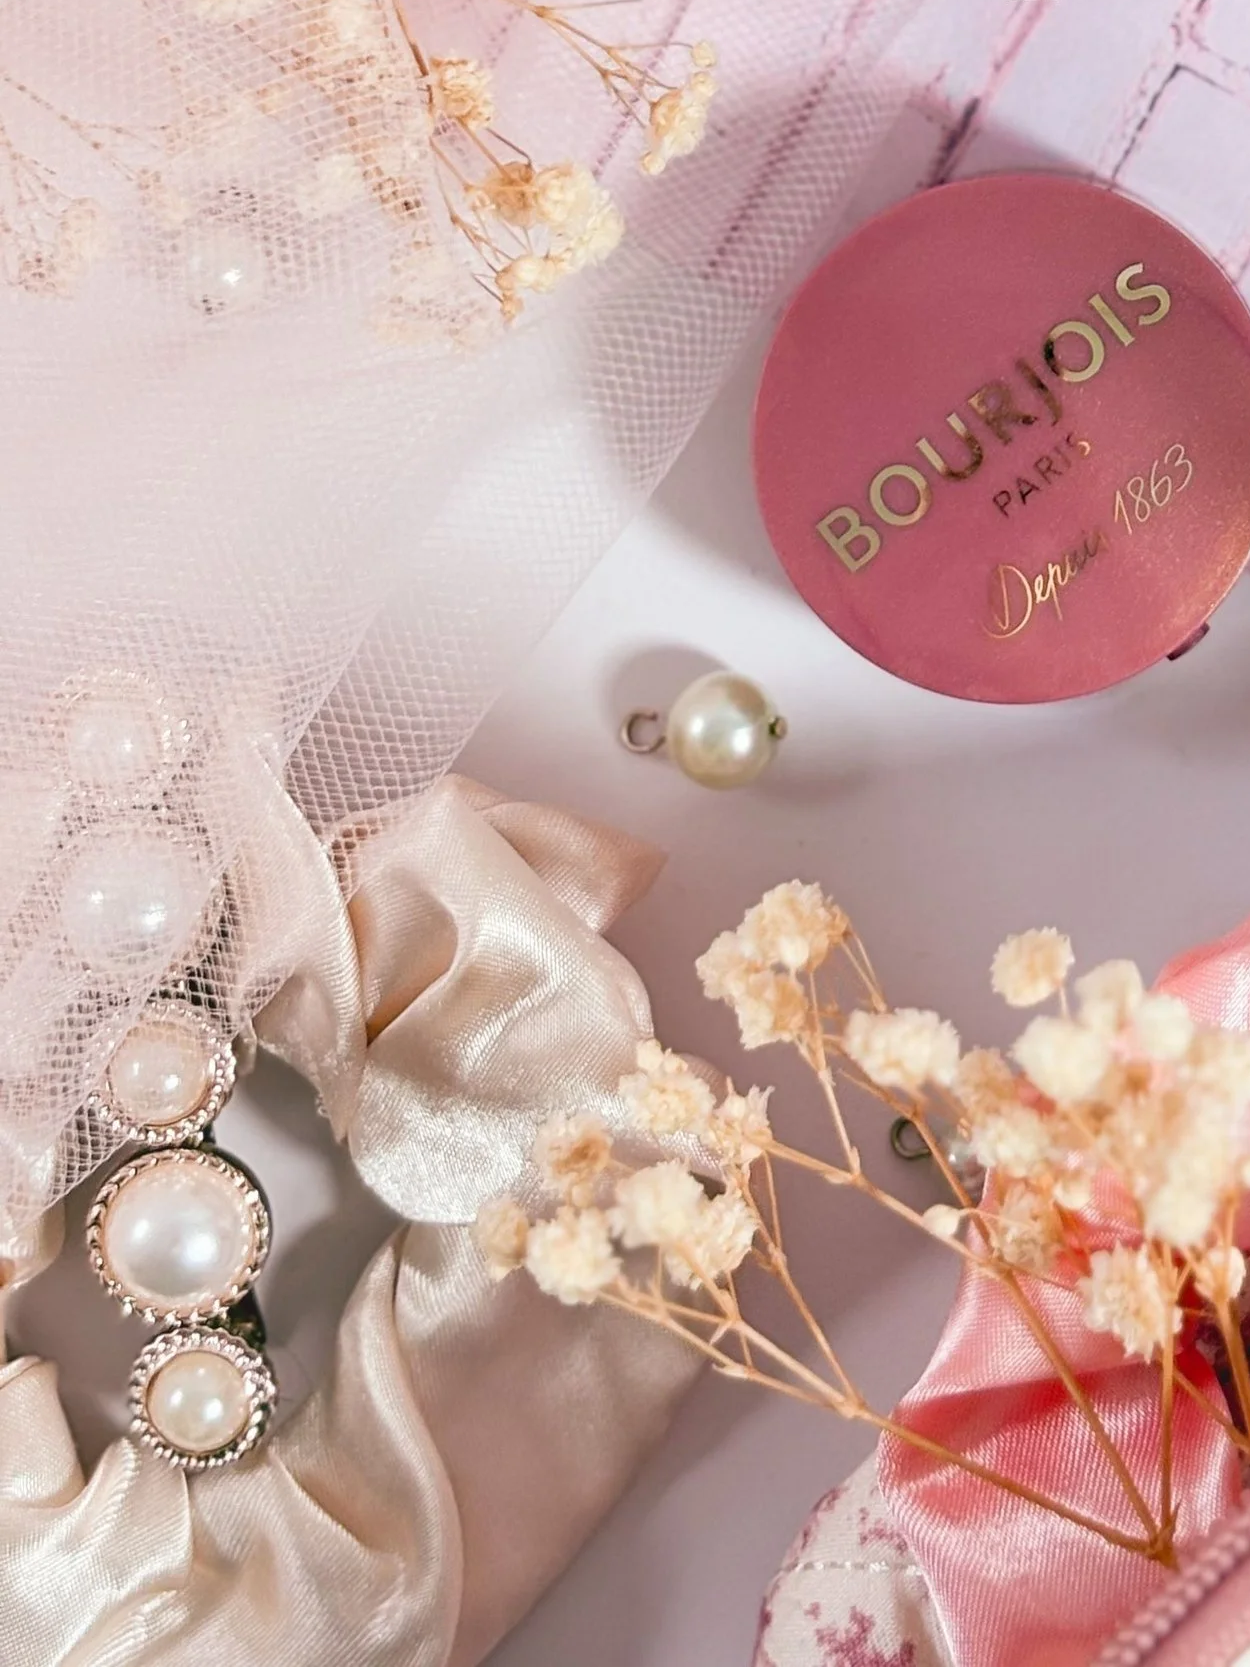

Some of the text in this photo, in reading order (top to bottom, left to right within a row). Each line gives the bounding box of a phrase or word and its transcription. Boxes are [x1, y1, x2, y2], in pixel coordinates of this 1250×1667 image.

[816, 262, 1172, 574] BOURJOIS
[991, 431, 1092, 519] PARIS
[1112, 443, 1195, 536] 1863
